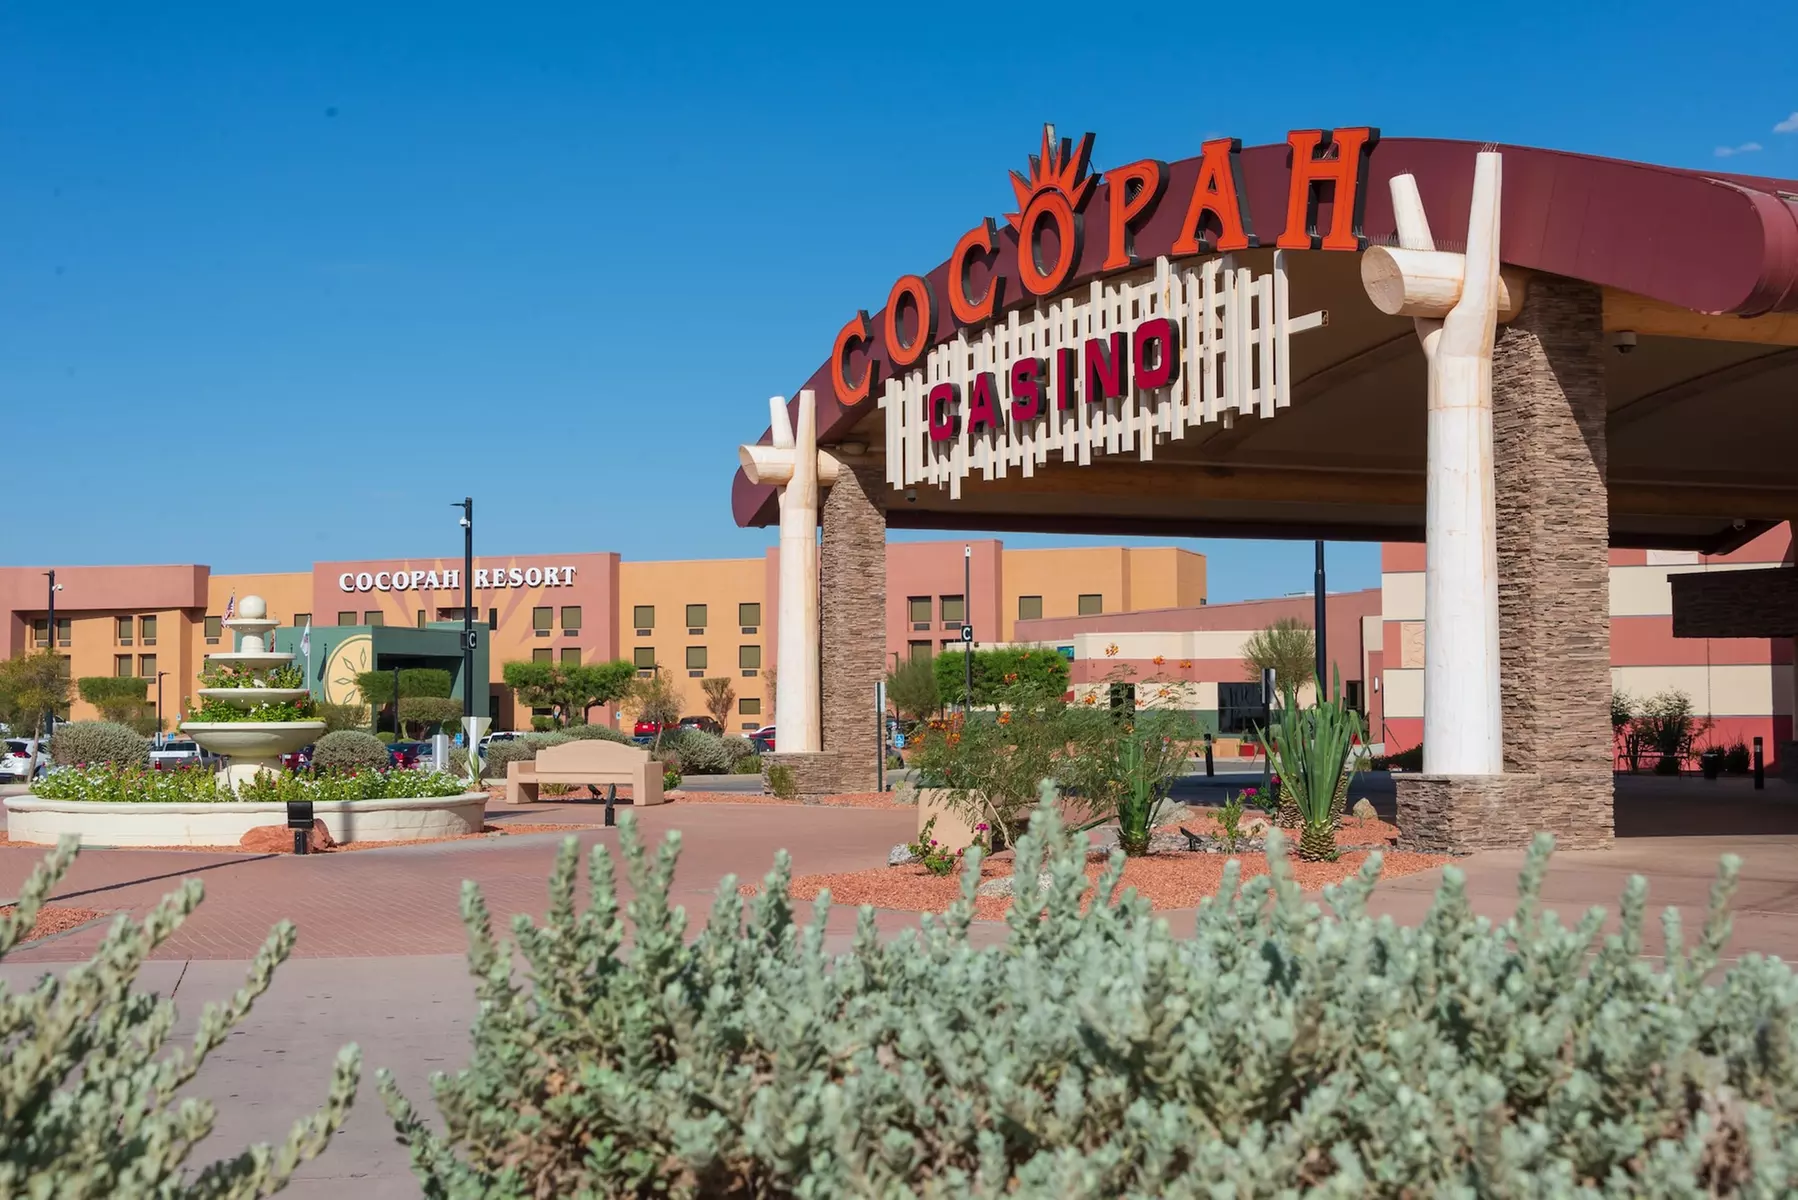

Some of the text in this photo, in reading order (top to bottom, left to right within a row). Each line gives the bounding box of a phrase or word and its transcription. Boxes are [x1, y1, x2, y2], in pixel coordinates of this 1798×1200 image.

[832, 126, 1377, 406] COCOPAH
[928, 317, 1178, 442] CASINO
[339, 566, 576, 591] COCOPAH RESORT
[469, 632, 476, 647] C
[963, 627, 971, 640] C
